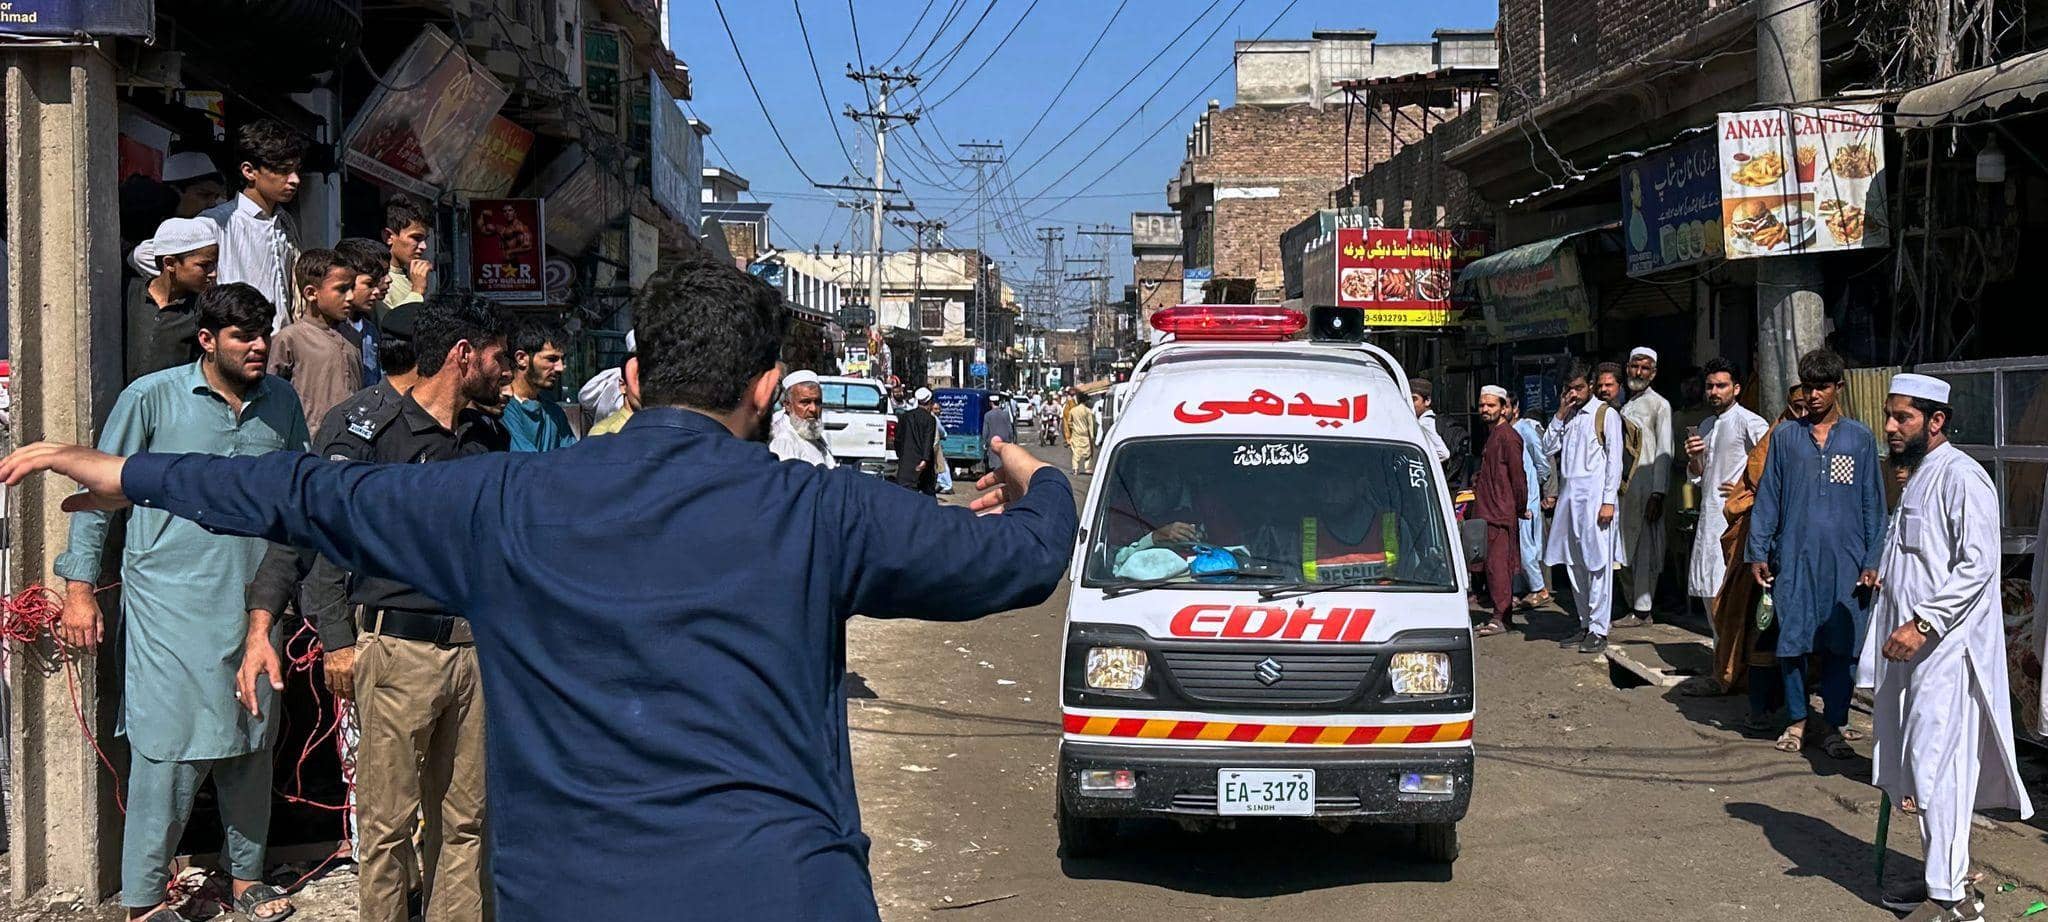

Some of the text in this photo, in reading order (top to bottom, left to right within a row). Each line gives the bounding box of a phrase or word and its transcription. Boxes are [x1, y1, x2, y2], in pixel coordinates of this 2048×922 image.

[1725, 116, 1786, 139] ANAYA
[1169, 604, 1376, 642] EDHI
[1225, 781, 1309, 802] EA-3178
